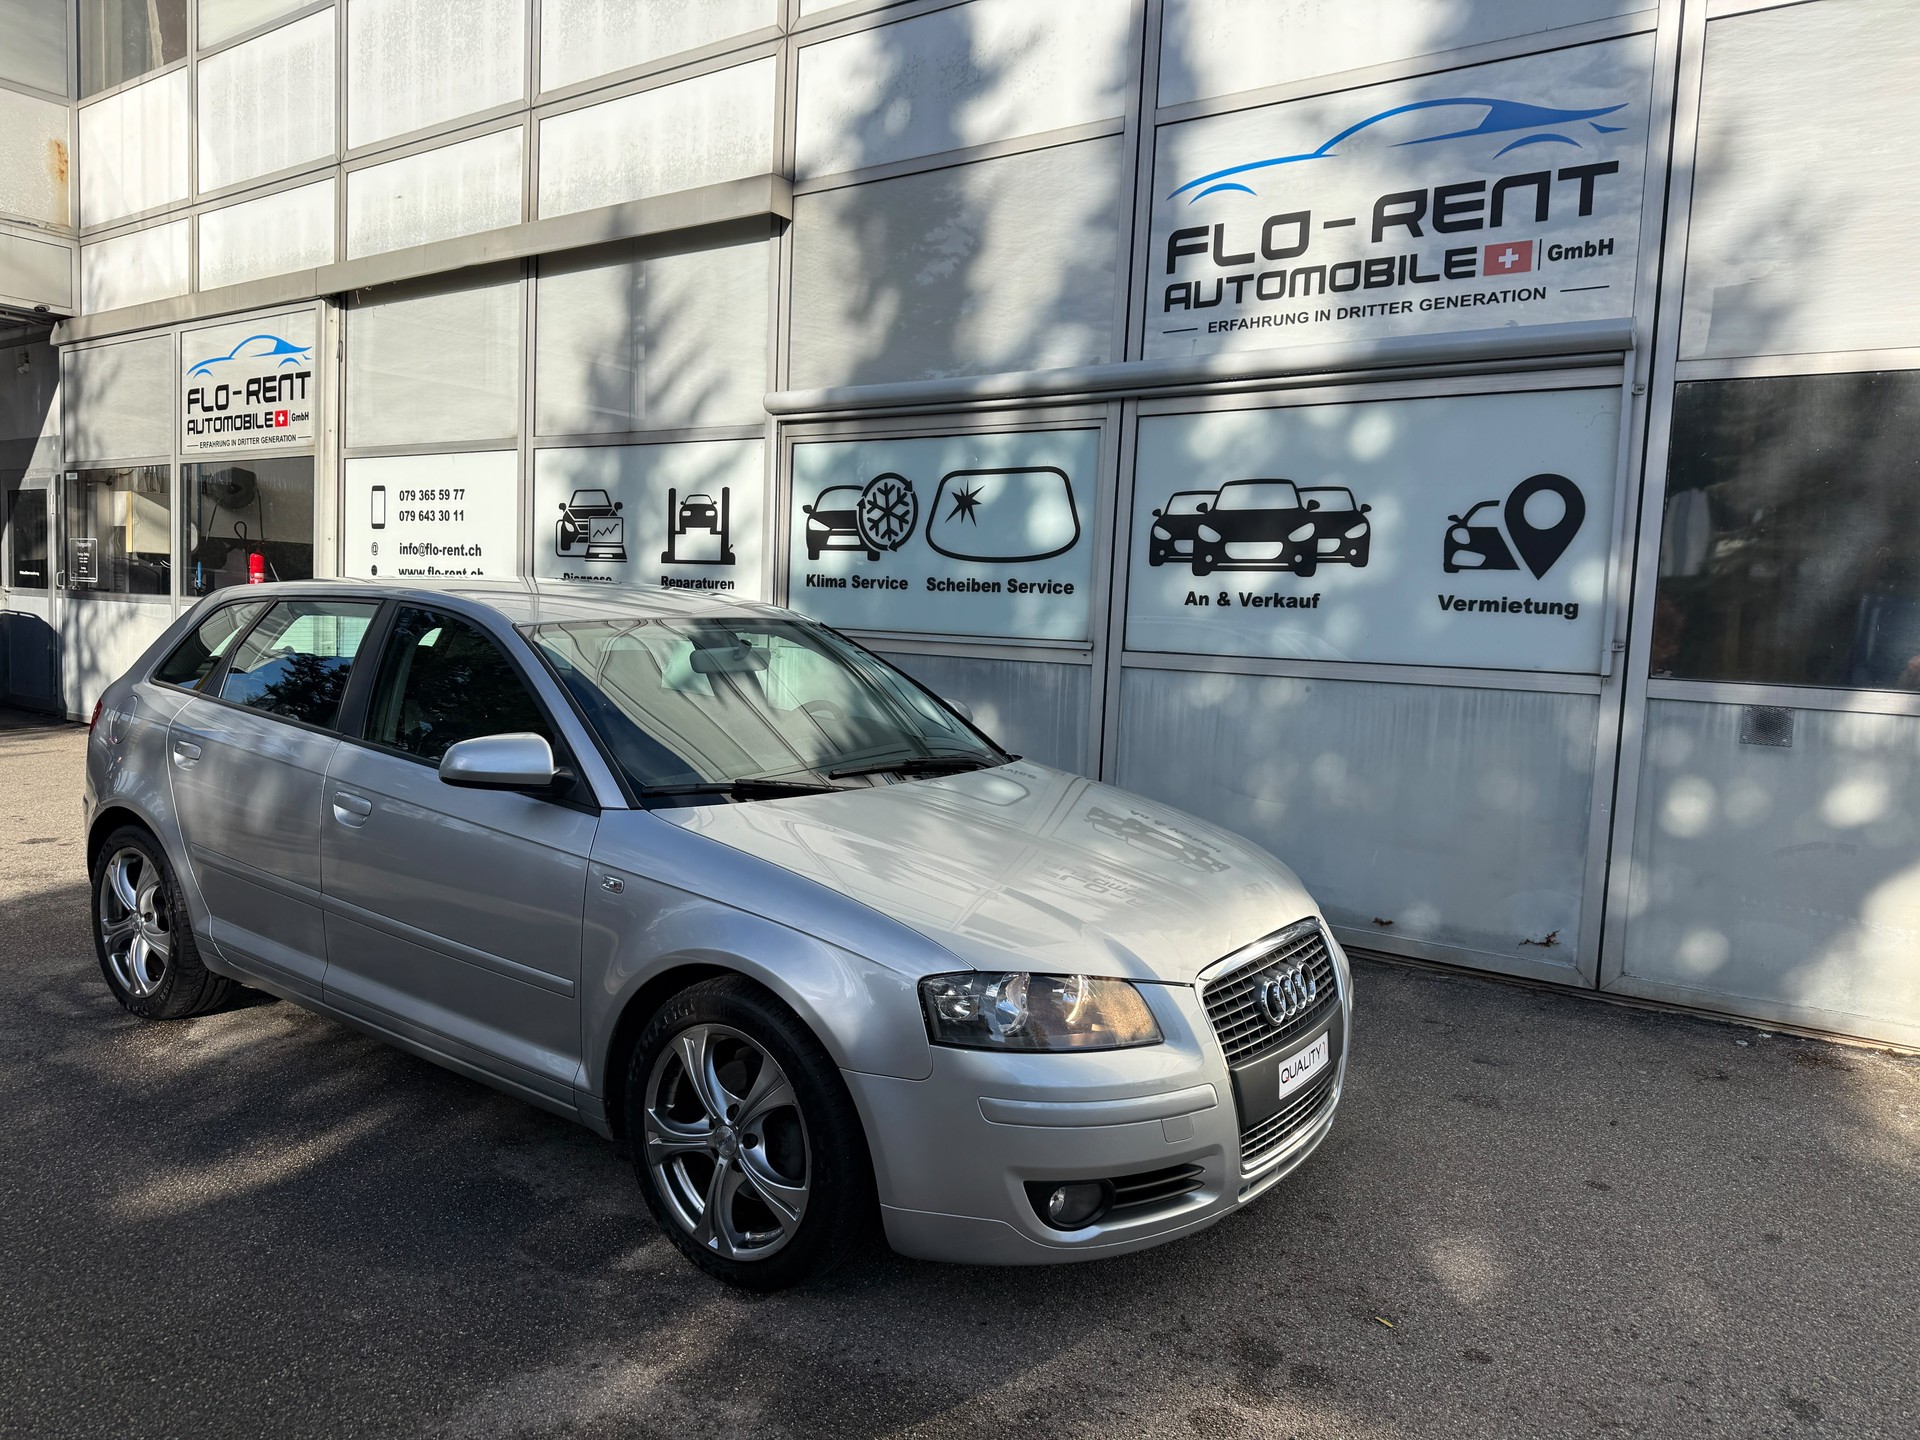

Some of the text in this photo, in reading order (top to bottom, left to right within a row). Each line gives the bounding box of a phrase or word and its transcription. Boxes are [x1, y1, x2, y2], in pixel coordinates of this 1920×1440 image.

[1166, 160, 1619, 274] FLO-RENT
[1163, 238, 1615, 313] AUTOMOBILE GmbH
[1207, 287, 1547, 334] ERFAHRUNG IN DRITTER GENERATION
[187, 371, 311, 414] FLO-RENT
[187, 411, 309, 435] AUTOMOBILE GmbH
[199, 434, 297, 449] ERFAHRUNG IN DRITTER GENERATION
[399, 488, 465, 501] 079 365 59 77
[399, 509, 464, 521] 079 643 30 11
[399, 542, 482, 557] info@flo-rent.ch
[660, 575, 735, 589] Reparaturen
[806, 573, 909, 591] Klima Service
[926, 576, 1075, 595] Scheiben Service
[1184, 591, 1321, 610] An & Verkauf
[1438, 594, 1580, 620] Vermietung
[1281, 1041, 1326, 1084] QUALITY 1
